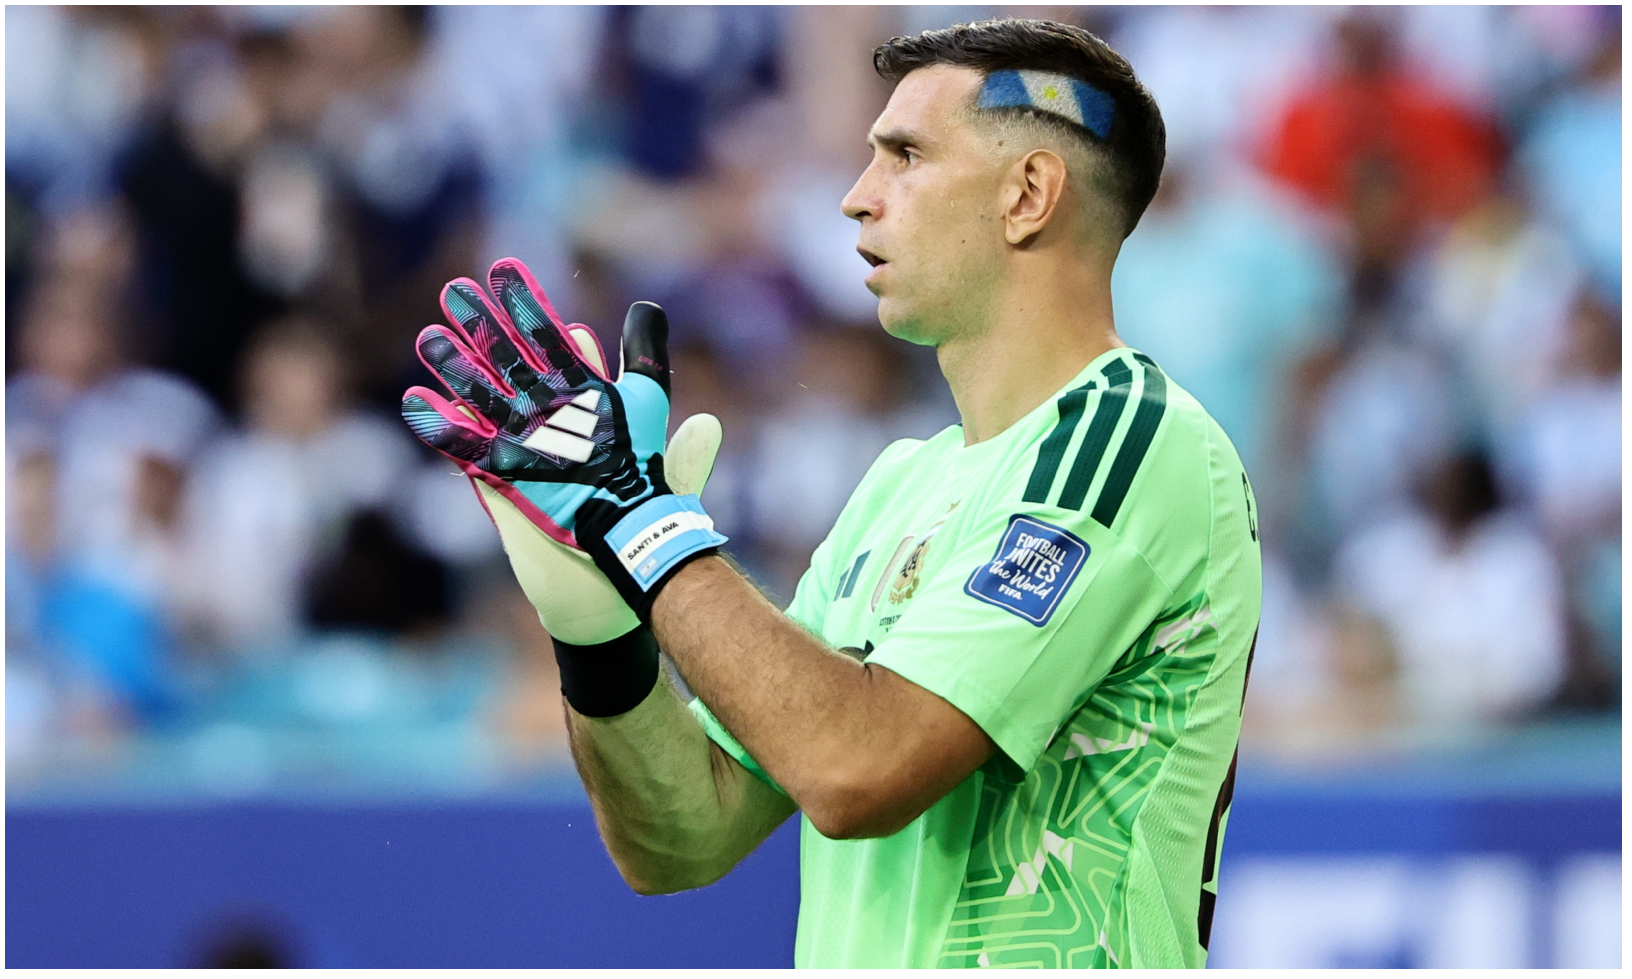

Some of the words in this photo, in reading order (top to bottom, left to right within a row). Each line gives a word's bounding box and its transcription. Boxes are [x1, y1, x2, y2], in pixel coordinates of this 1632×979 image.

[627, 536, 653, 561] SANTI
[652, 531, 661, 540] &
[661, 521, 680, 535] AVA
[1016, 532, 1067, 567] FOOTBALL
[988, 559, 1011, 579] the
[1010, 569, 1055, 600] World
[998, 583, 1023, 600] FIFA
